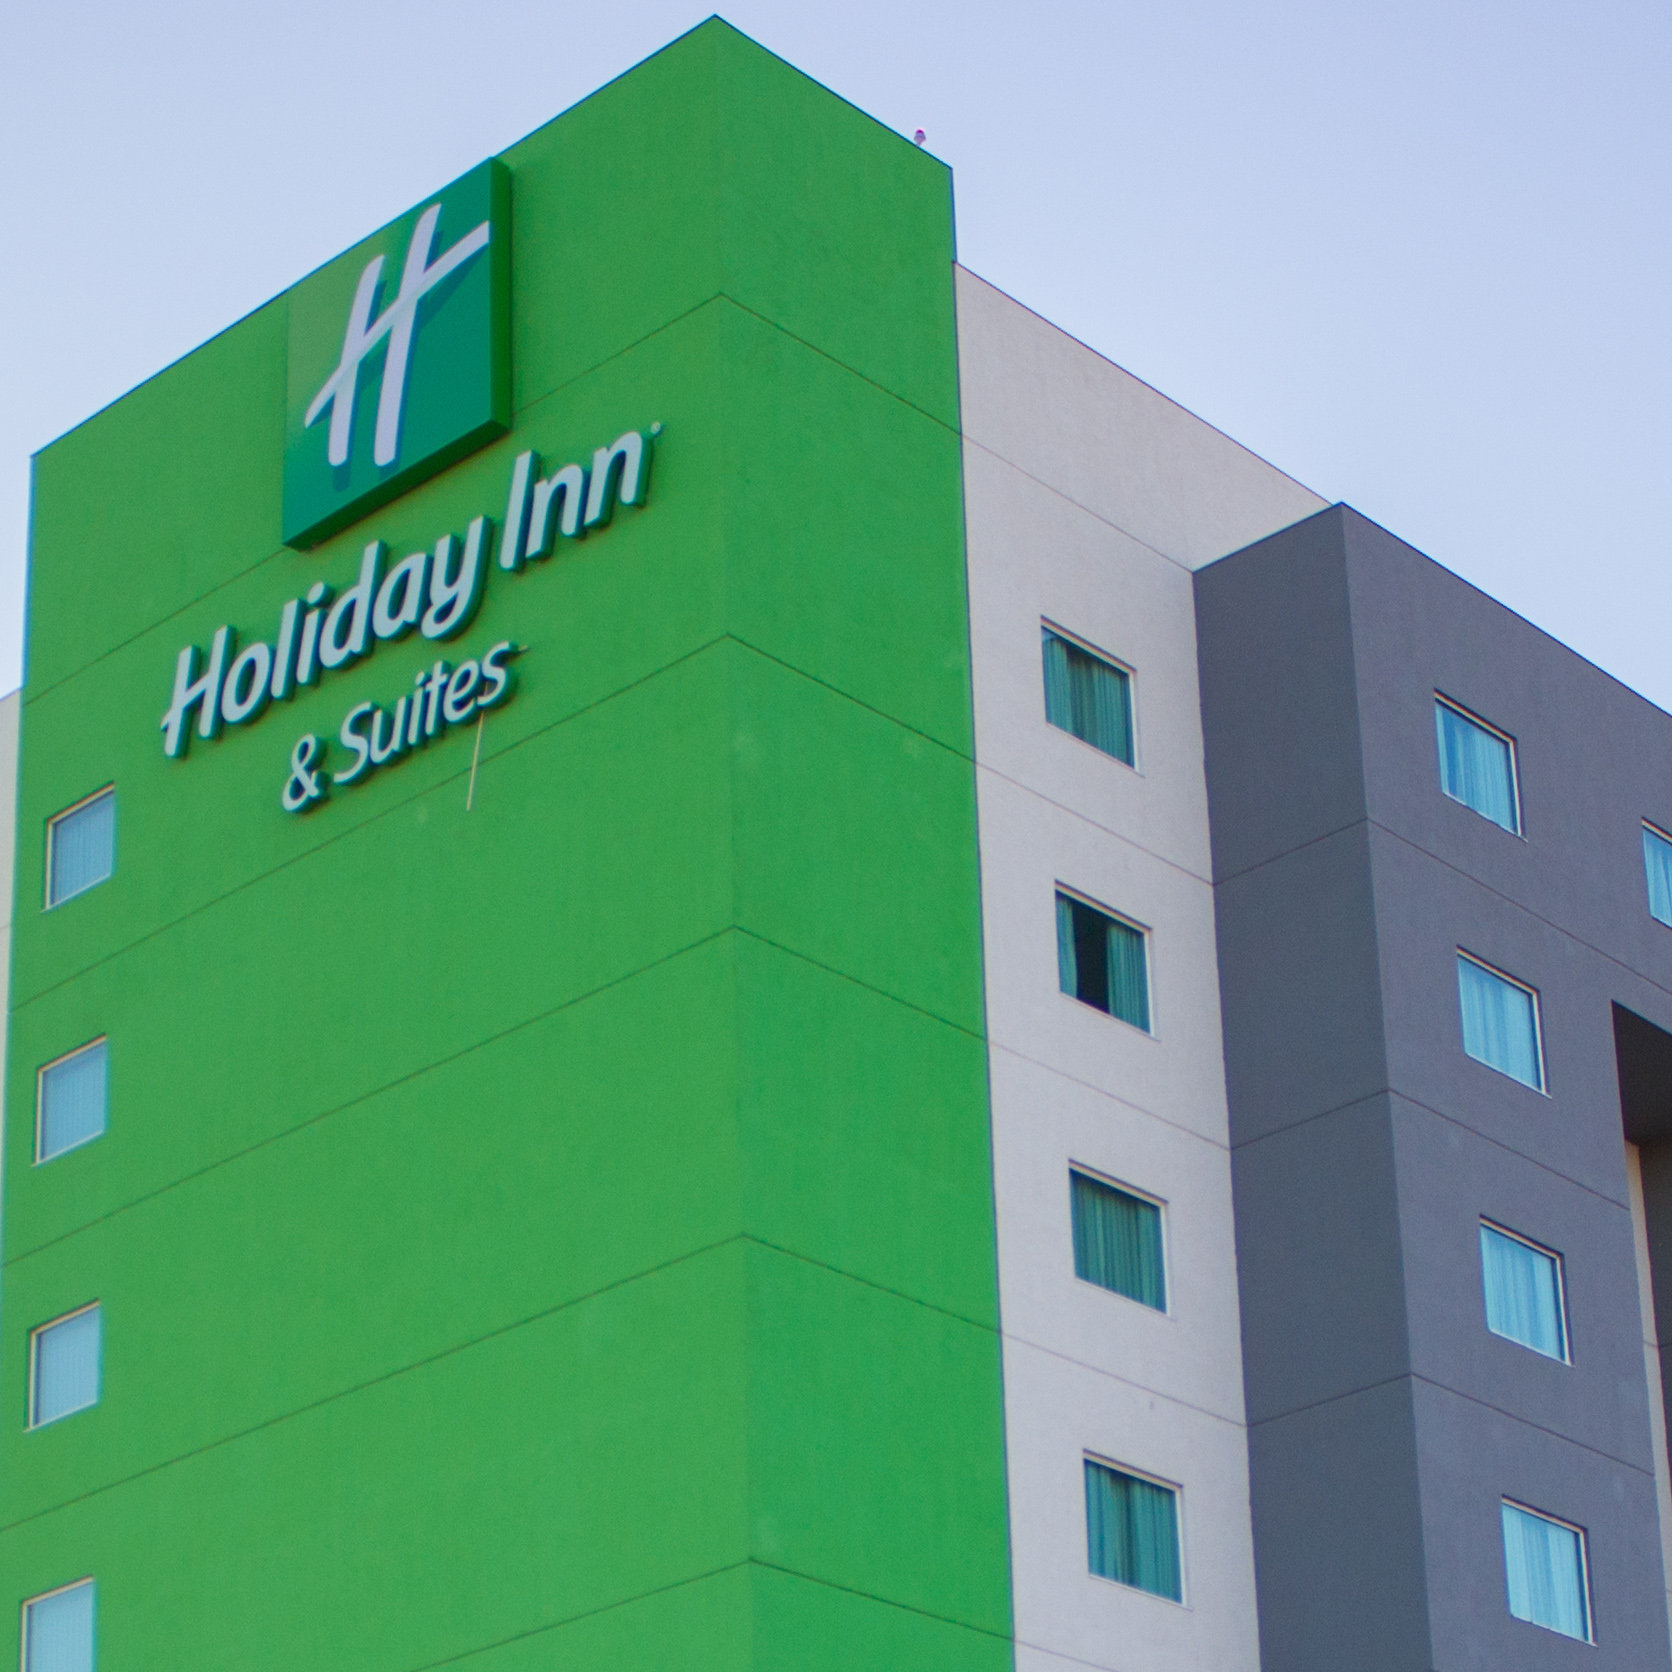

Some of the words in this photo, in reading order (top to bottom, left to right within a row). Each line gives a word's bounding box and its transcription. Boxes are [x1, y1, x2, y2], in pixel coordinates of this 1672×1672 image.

[160, 514, 494, 760] Holiday
[499, 430, 654, 572] Inn
[282, 732, 326, 814] &
[333, 642, 518, 785] Suites
